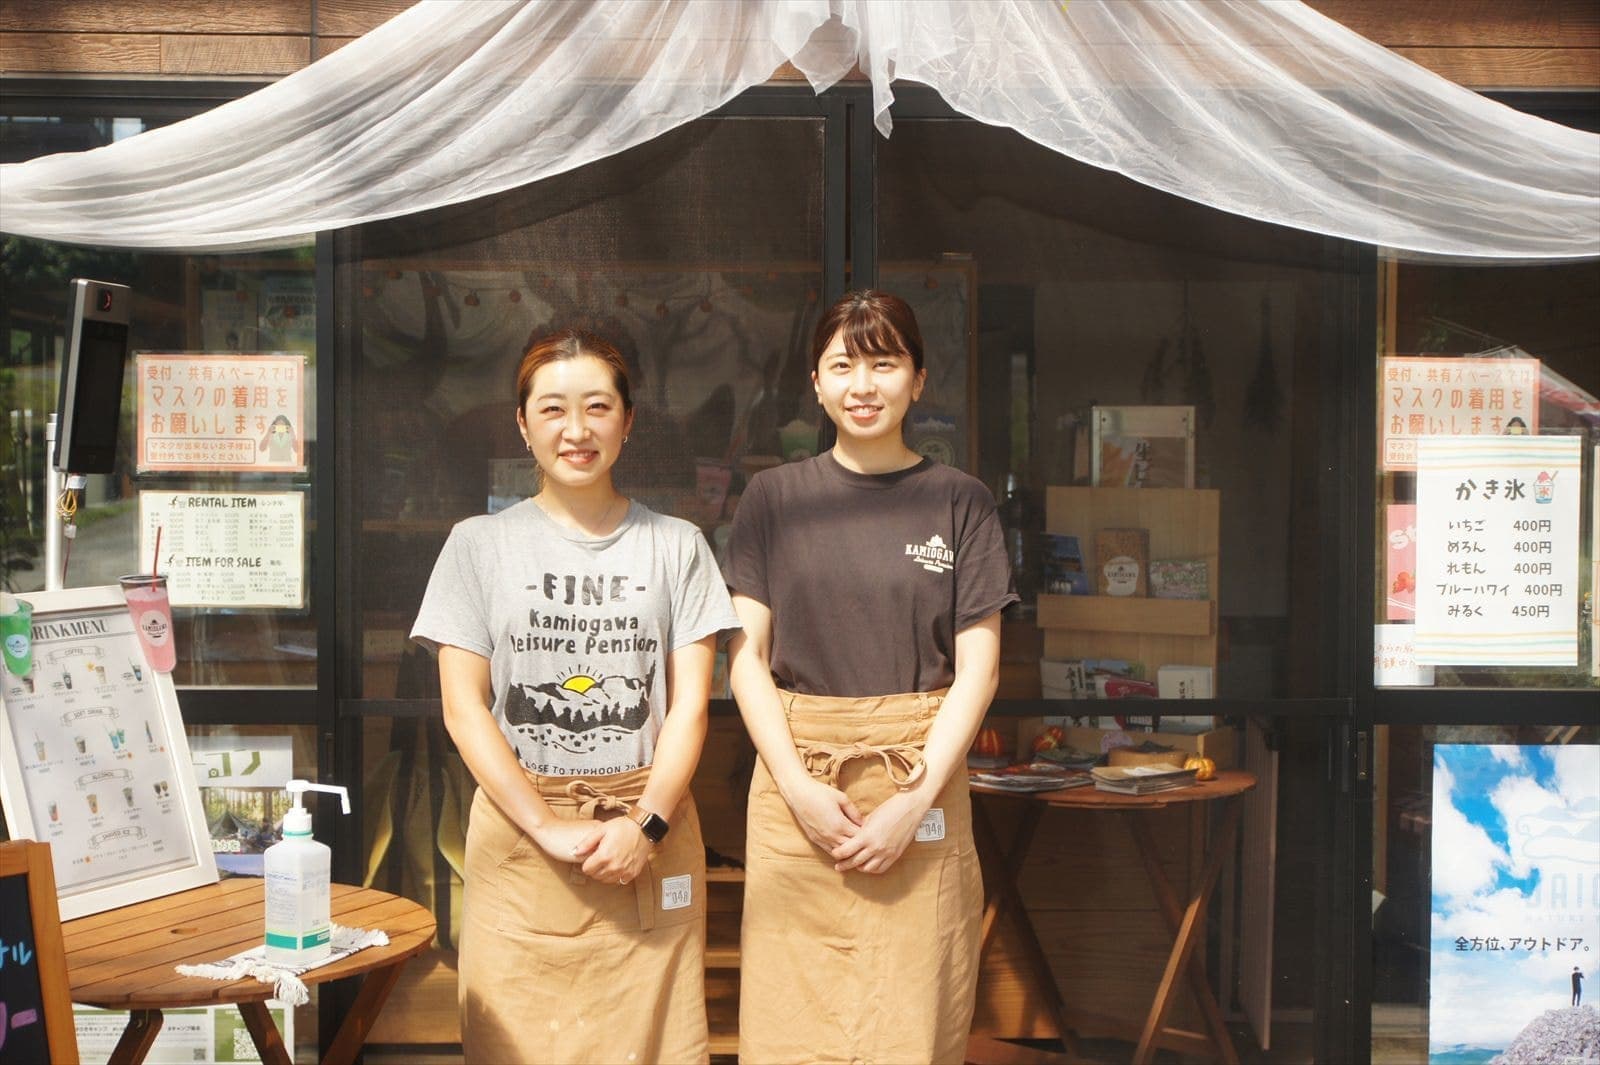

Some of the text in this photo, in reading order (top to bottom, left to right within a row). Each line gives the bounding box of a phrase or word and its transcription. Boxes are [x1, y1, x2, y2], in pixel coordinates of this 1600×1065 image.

[147, 366, 295, 380] 受付・共有スペースでは
[152, 386, 288, 409] マスクの着用を
[1392, 387, 1523, 410] マスクの着用を
[152, 413, 267, 435] お願いします
[1390, 414, 1504, 435] お願いします
[1456, 478, 1525, 501] かき氷
[188, 497, 228, 509] RENTAL
[231, 497, 257, 508] ITEM
[1448, 519, 1551, 533] いちご 400円
[1447, 540, 1552, 554] めろん 400円
[185, 557, 211, 568] ITEM
[214, 557, 234, 568] FOR
[237, 557, 262, 568] SALE
[1447, 562, 1552, 575] れもん 400円
[1436, 583, 1563, 596] ブルーハワイ 400円
[1447, 604, 1550, 617] みるく 450円
[529, 608, 639, 636] Kamiogawa
[553, 766, 565, 775] TO
[570, 766, 621, 775] TYPHOON
[1455, 936, 1590, 952] 全方位、アウトドア。
